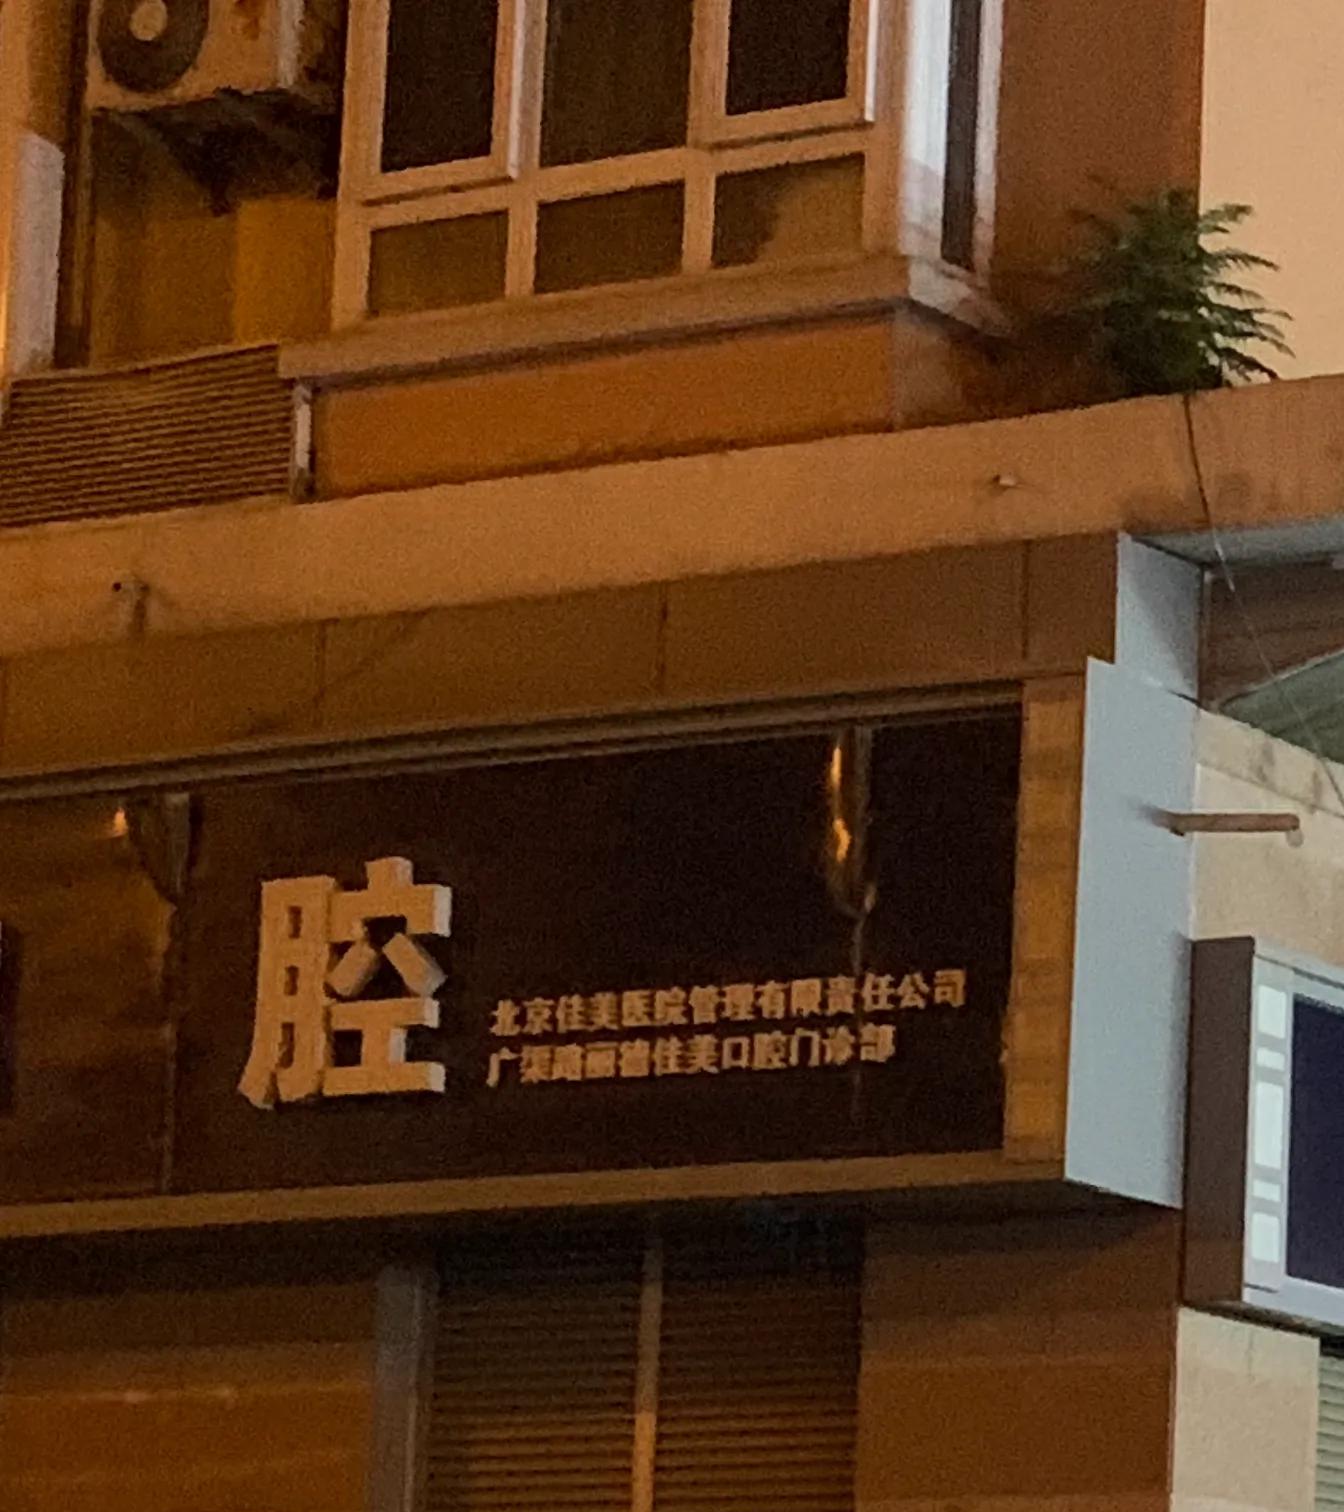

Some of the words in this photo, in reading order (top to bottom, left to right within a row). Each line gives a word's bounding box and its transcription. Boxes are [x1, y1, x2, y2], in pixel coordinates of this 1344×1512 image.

[238, 857, 452, 1110] 腔
[489, 968, 968, 1037] 北京佳美医院管理有限责任公司
